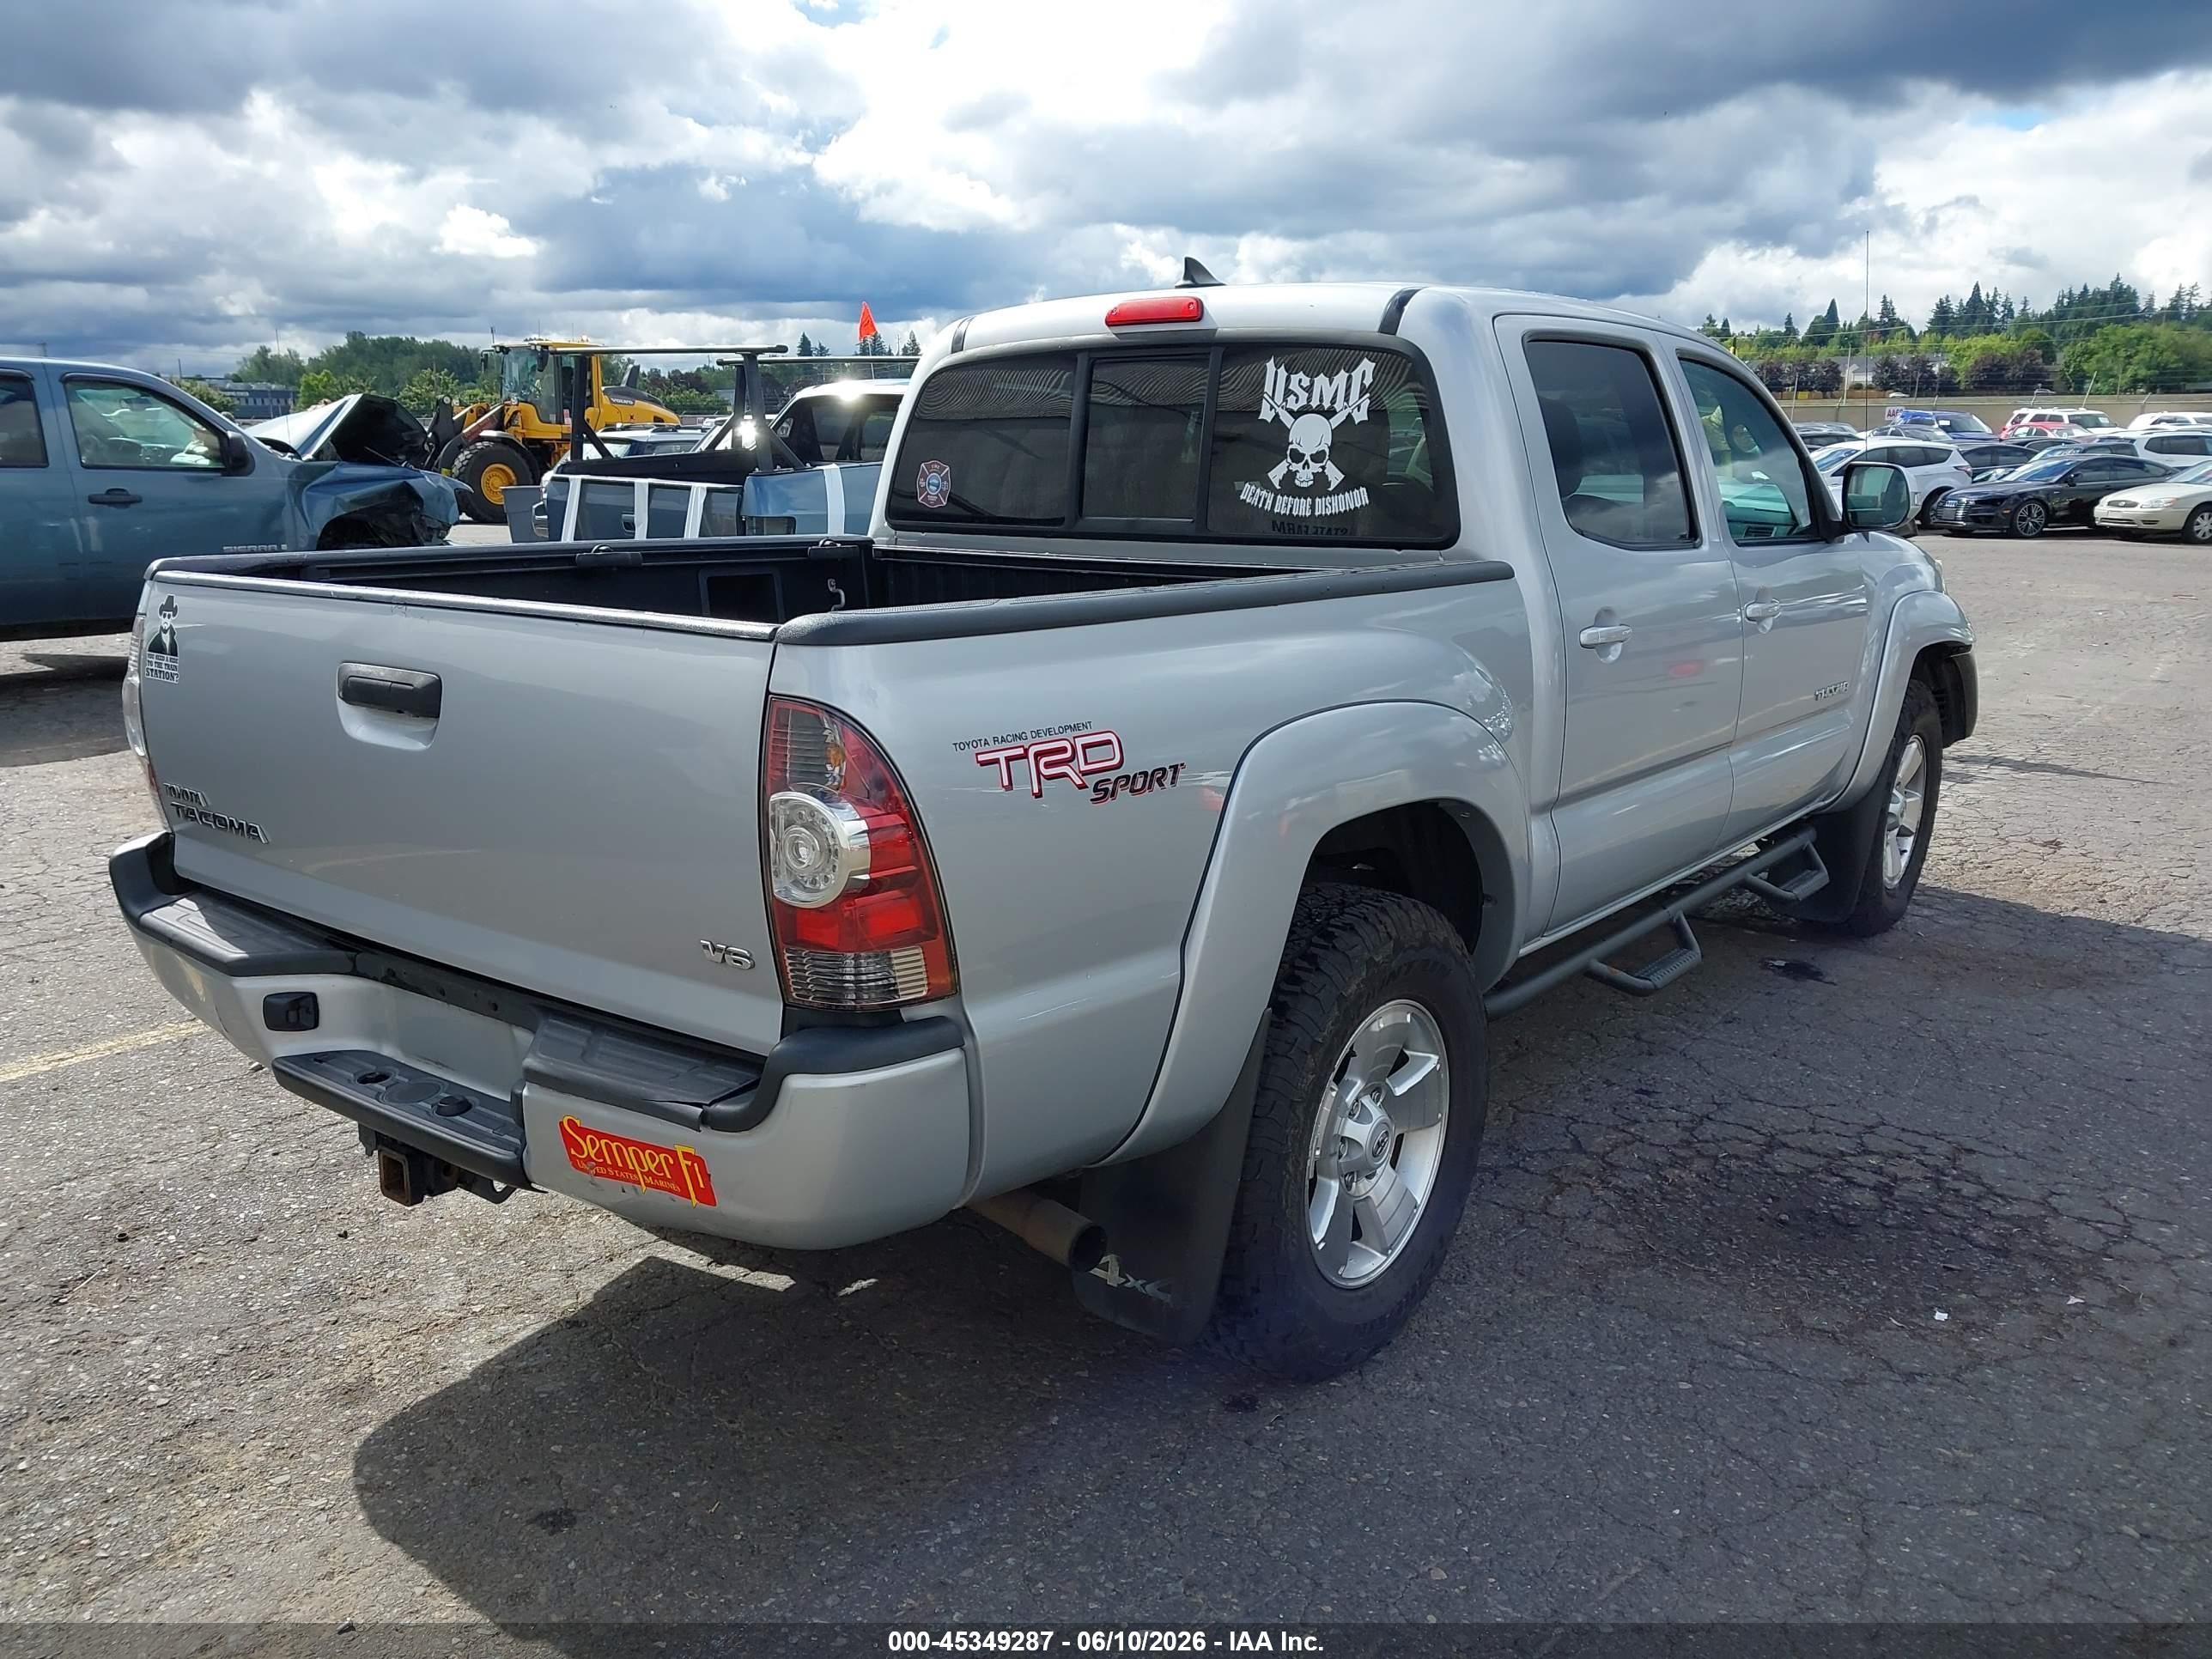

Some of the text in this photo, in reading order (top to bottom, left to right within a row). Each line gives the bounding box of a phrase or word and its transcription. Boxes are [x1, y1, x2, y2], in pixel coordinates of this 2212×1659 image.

[1258, 355, 1376, 425] USMC
[1239, 483, 1370, 517] DEATH BEFORE DISHONOR
[146, 667, 179, 682] STATION?
[952, 720, 1093, 752] TOYOTA RACING DEVELOPMENT
[975, 730, 1125, 799] TRD
[163, 782, 208, 808] TOYOTA
[1090, 763, 1186, 804] SPORT
[171, 801, 269, 844] TACOMA
[700, 940, 755, 969] V6
[562, 1115, 674, 1194] Semper
[577, 1159, 681, 1193] UNTED STATES MARINES
